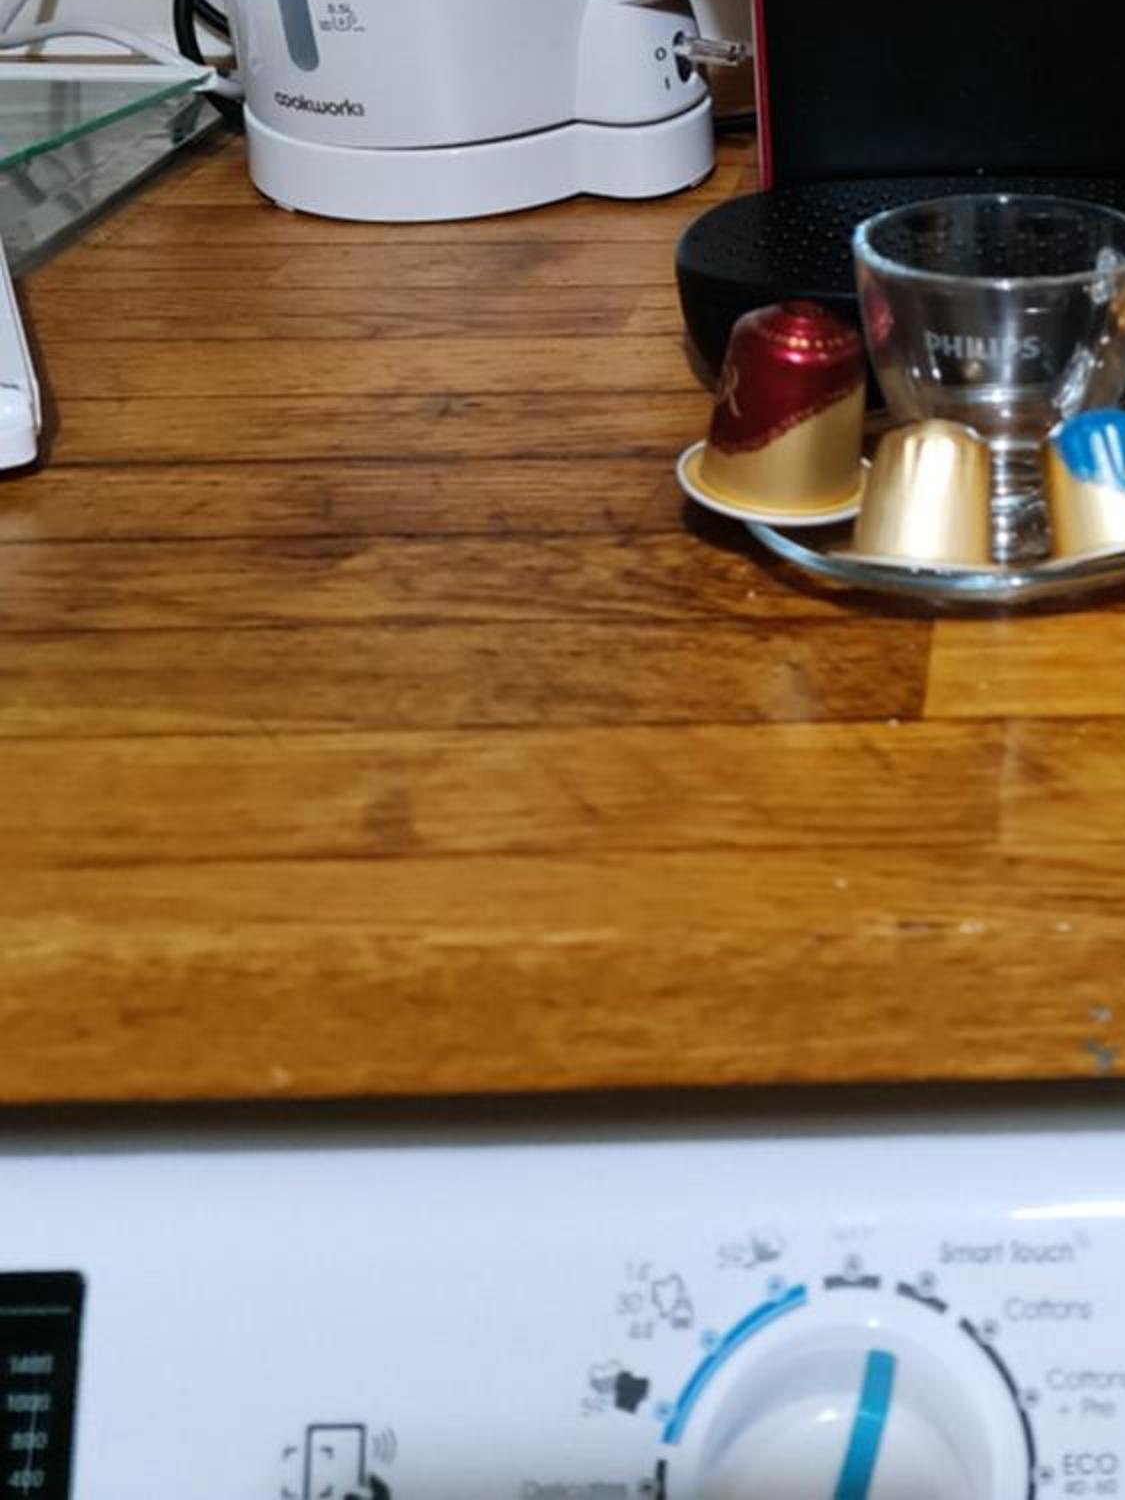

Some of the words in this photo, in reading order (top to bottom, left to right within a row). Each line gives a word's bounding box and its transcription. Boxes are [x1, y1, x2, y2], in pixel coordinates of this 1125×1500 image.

[926, 332, 1041, 360] PHILIPS
[940, 1240, 1003, 1265] Smart
[1011, 1240, 1076, 1265] Touch
[1003, 1298, 1093, 1322] Cottons
[1062, 1453, 1119, 1476] ECO
